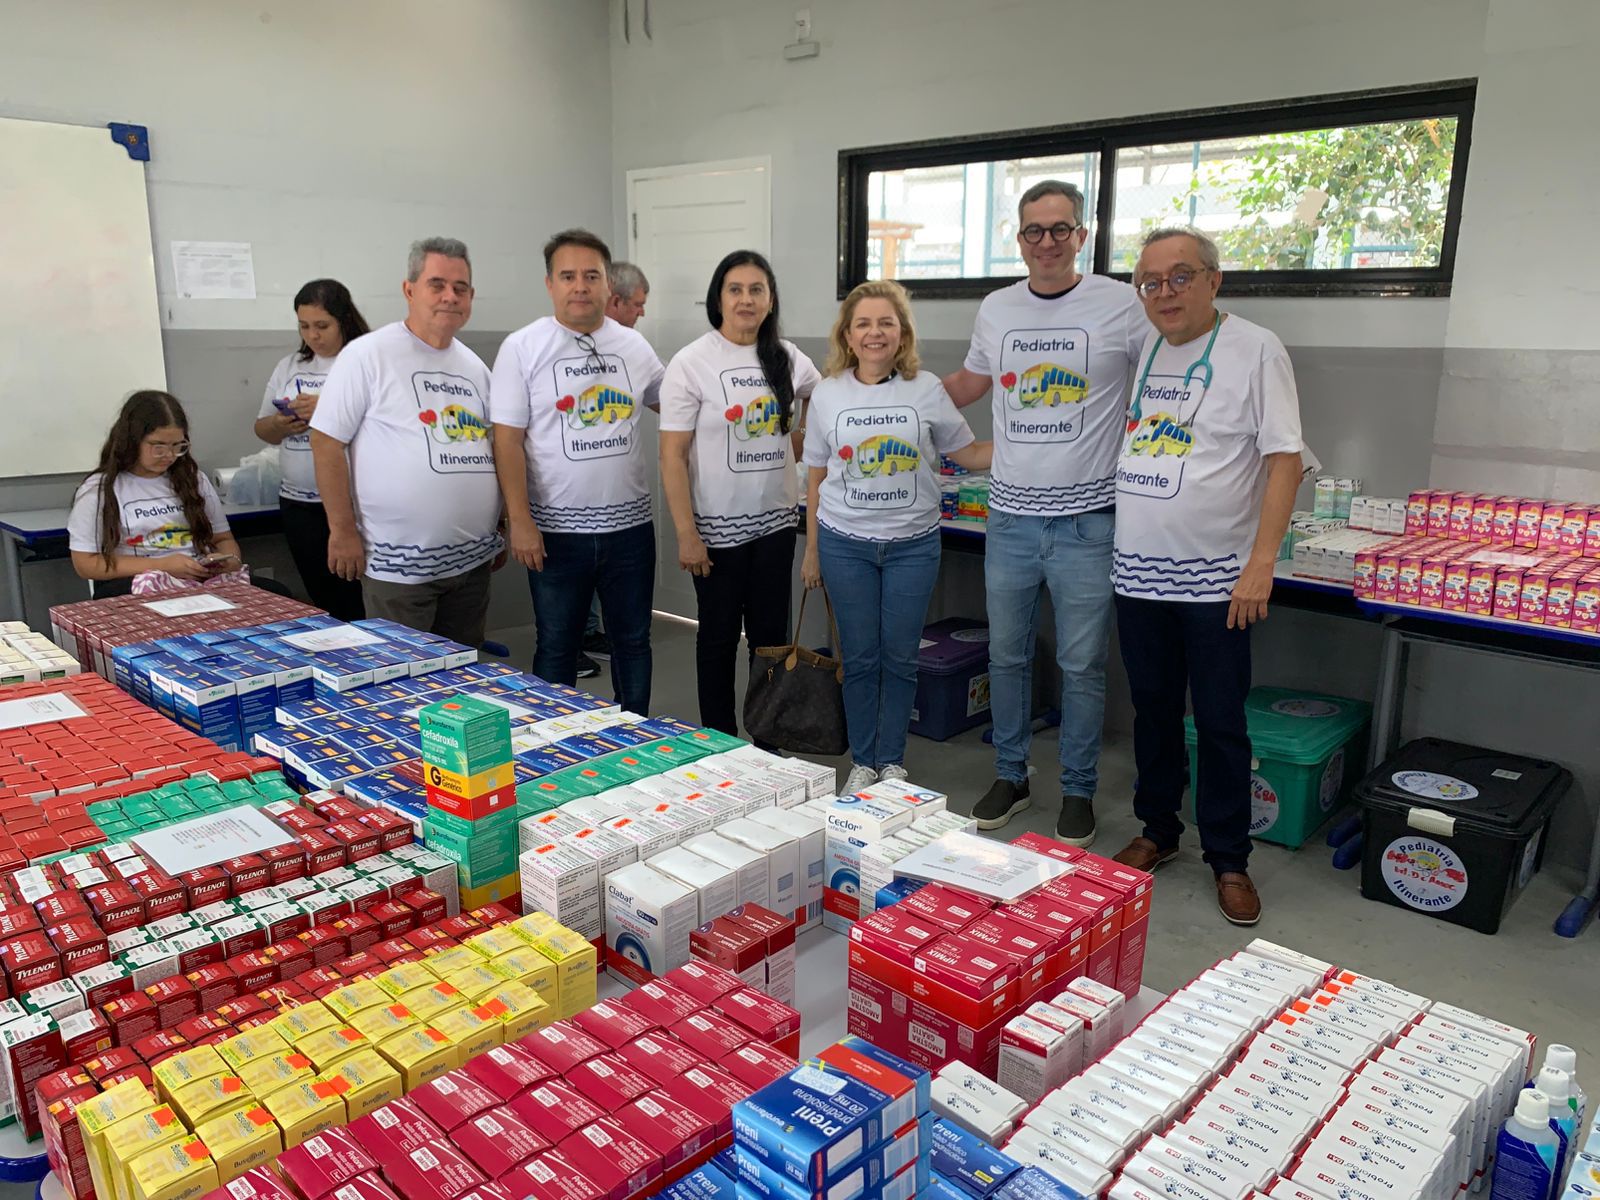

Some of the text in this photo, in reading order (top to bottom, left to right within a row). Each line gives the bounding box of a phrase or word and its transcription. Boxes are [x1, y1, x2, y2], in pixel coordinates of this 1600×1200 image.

[1013, 338, 1074, 352] Pediatria
[565, 364, 617, 376] Pediatria
[424, 381, 472, 397] Pediatria
[731, 376, 769, 387] Pediat
[1142, 385, 1191, 400] Pediatria
[847, 414, 907, 427] Pediatria
[1011, 421, 1072, 433] Itinerante
[572, 435, 627, 451] Itinerante
[737, 448, 785, 463] Itinerante
[851, 488, 908, 501] Itinerante
[422, 729, 458, 748] cefadroxila
[430, 767, 441, 786] G
[828, 815, 859, 831] Ceclor
[351, 838, 378, 852] TYLENOL
[274, 856, 303, 870] TYLENOL
[316, 850, 343, 864] TYLENOL
[1400, 842, 1453, 868] Pediatria
[236, 868, 266, 882] TYLENOL
[193, 881, 226, 896] TYLENOL
[609, 885, 632, 904] Clabat
[1394, 879, 1451, 907] Itinerante
[149, 892, 183, 907] TYLENOL
[908, 898, 936, 913] HPMIX
[106, 906, 141, 922] TYLENOL
[1006, 905, 1036, 919] HPMIX
[864, 918, 893, 934] HPMIX
[969, 929, 999, 945] HPMIX
[66, 944, 104, 960] TYLENOL
[926, 949, 958, 965] HPMIX
[16, 962, 56, 980] TYLENOL
[245, 972, 273, 986] TYLENOL
[851, 1001, 879, 1022] AMOSTRA
[912, 1034, 943, 1055] AMOSTRA
[529, 1059, 547, 1075] Prelone
[629, 1073, 650, 1088] Prelone
[472, 1088, 491, 1104] Prelone
[575, 1100, 596, 1117] Prelone
[745, 1100, 785, 1127] eurofarma
[793, 1088, 856, 1125] prednisolona
[679, 1110, 702, 1127] Prelone
[791, 1106, 843, 1137] Preni
[414, 1121, 432, 1140] Prelone
[735, 1118, 759, 1141] Preni
[932, 1122, 963, 1143] Preni
[519, 1130, 539, 1147] Prelone
[628, 1140, 650, 1160] Prelone
[346, 1150, 364, 1169] Prelone
[738, 1153, 760, 1176] Preni
[454, 1163, 474, 1184] Prelone
[571, 1175, 594, 1195] Prelone
[692, 1172, 721, 1194] Preni
